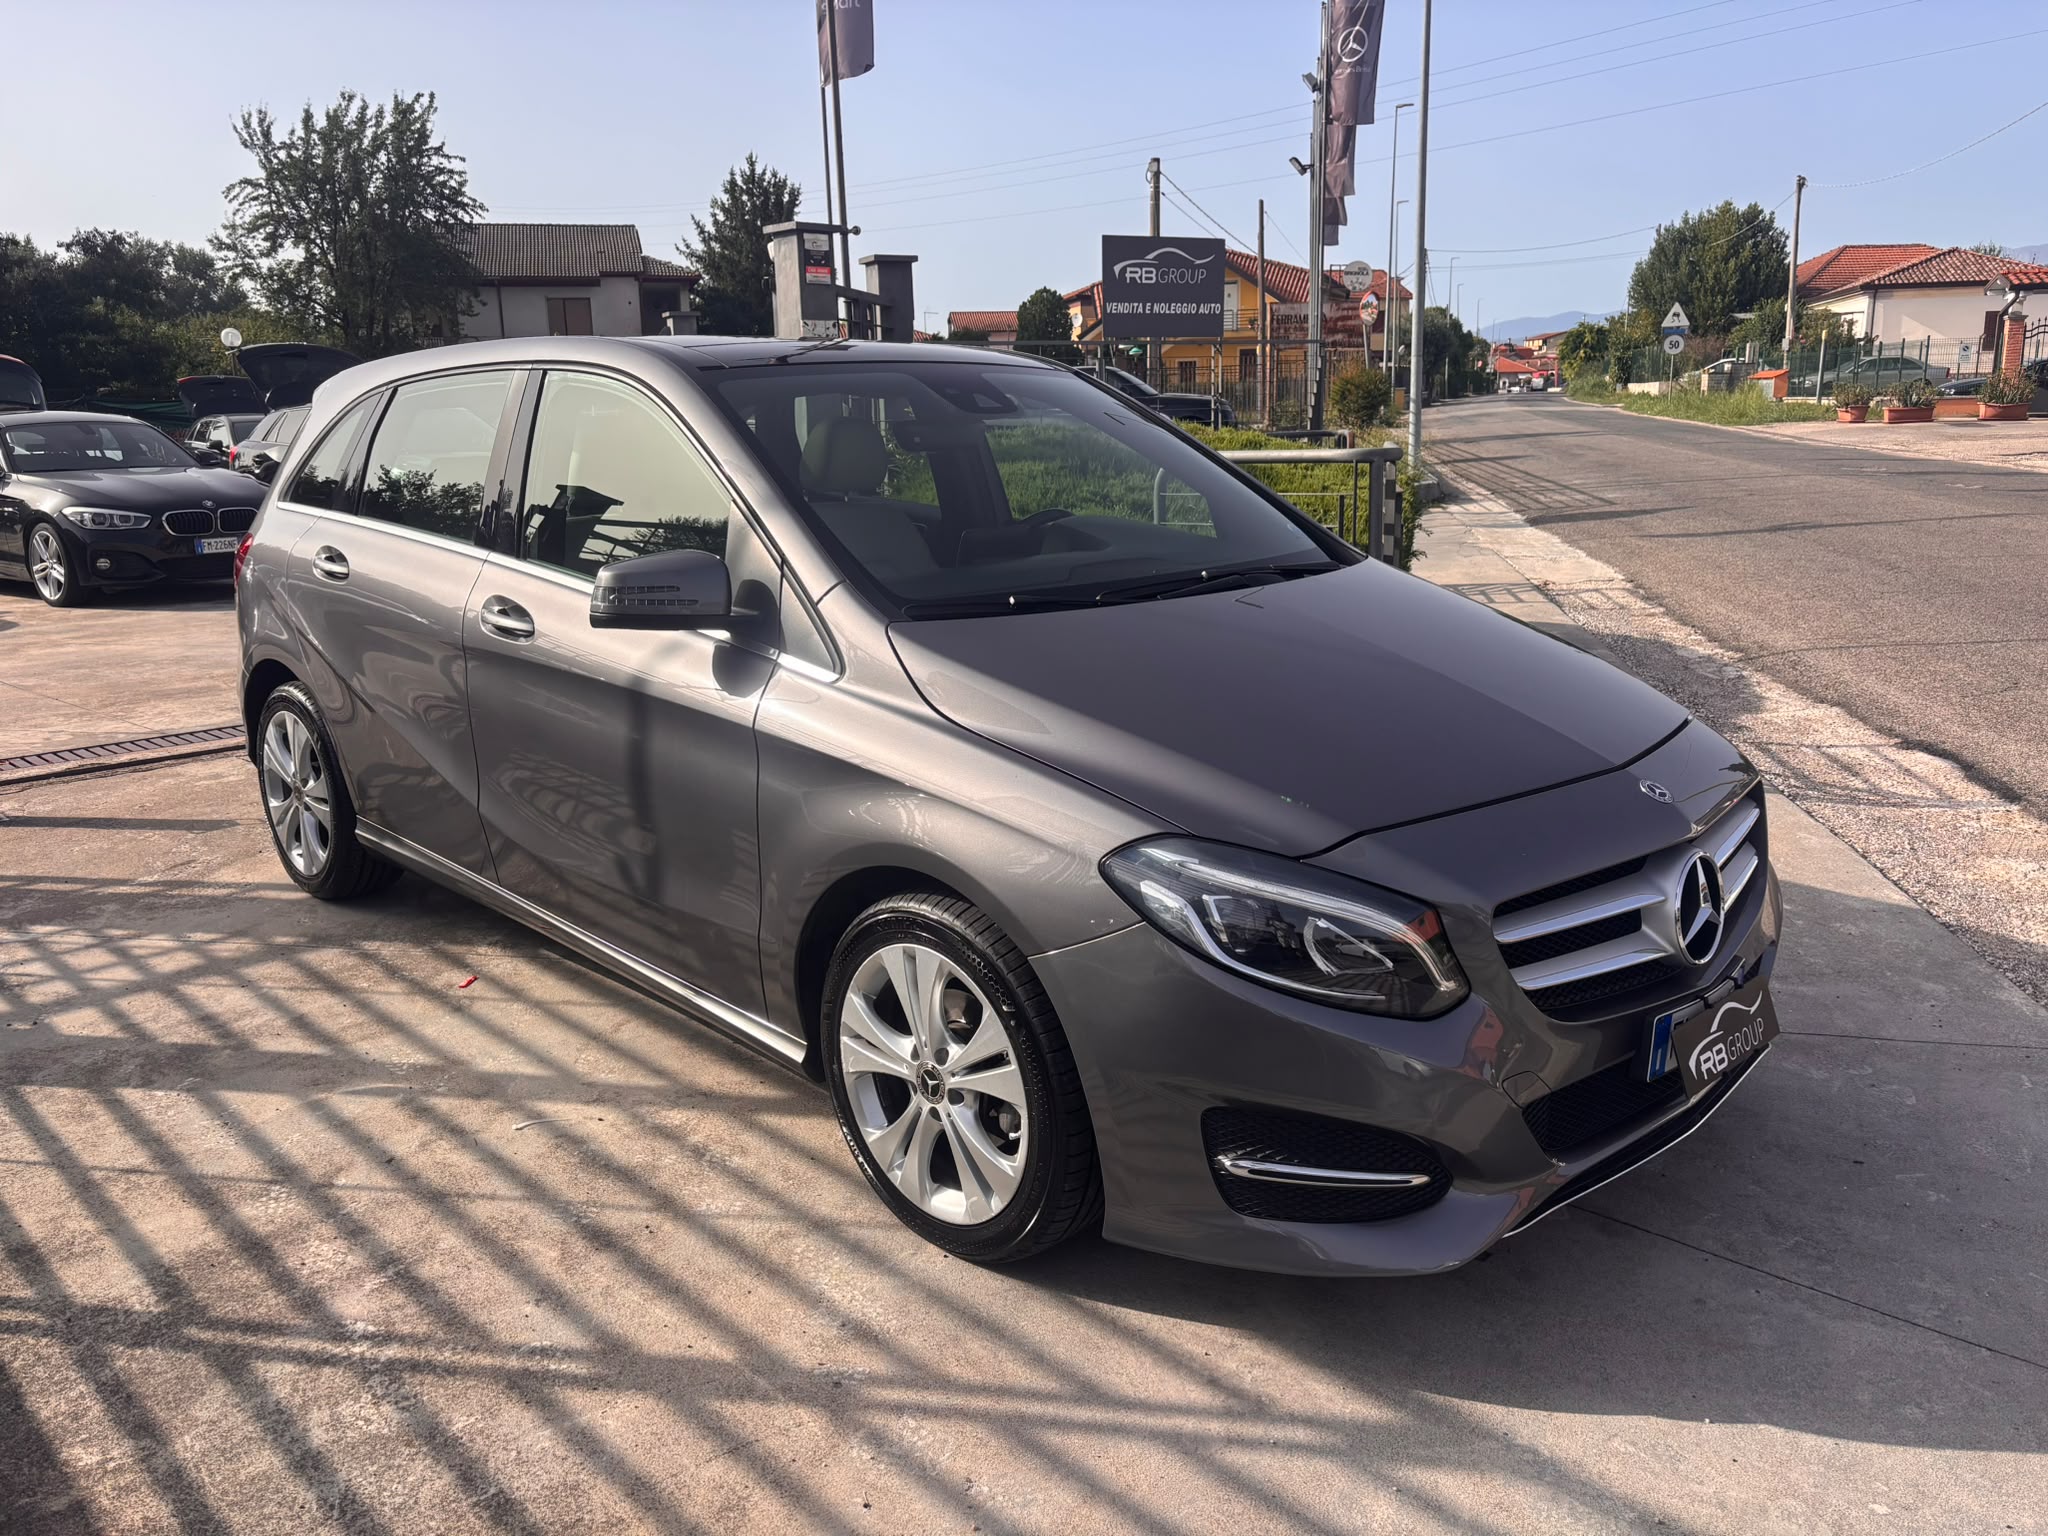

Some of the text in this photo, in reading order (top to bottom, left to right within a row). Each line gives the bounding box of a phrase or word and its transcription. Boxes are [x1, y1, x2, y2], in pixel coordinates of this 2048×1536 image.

[1106, 302, 1221, 315] VENDITA E NOLEGGIO AUTO
[1668, 340, 1680, 350] 50
